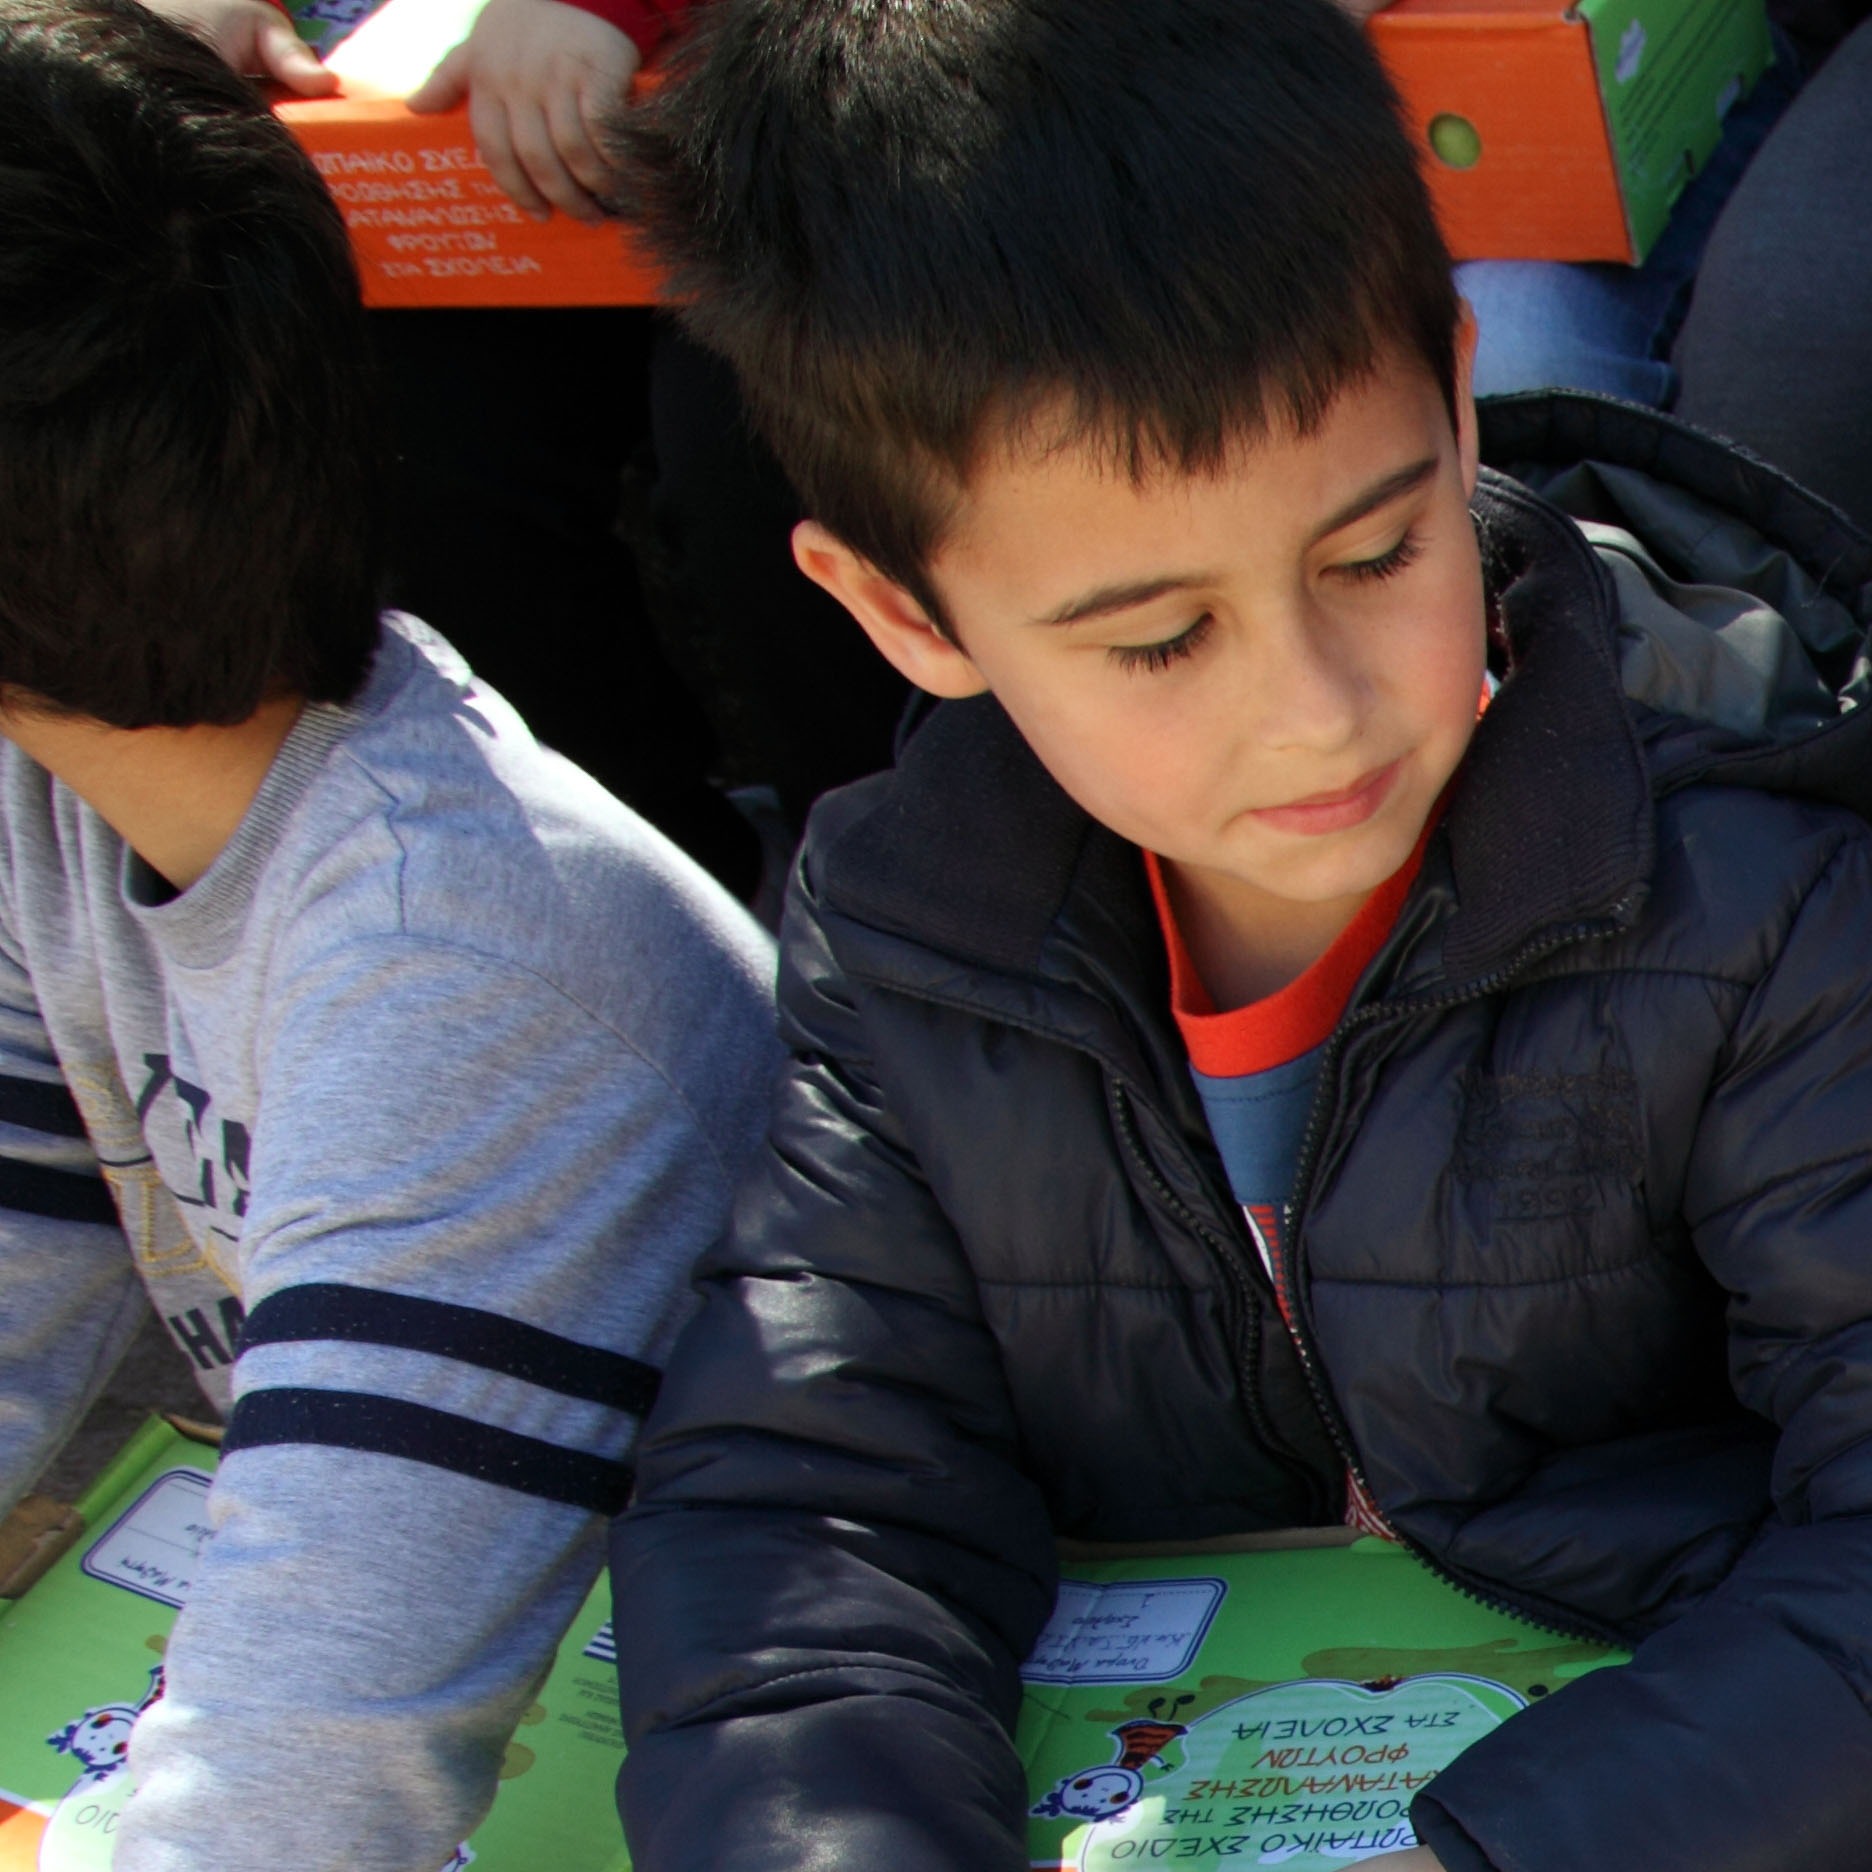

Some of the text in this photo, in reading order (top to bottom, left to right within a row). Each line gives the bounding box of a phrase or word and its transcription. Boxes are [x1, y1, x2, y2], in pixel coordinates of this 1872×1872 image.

[348, 203, 525, 228] ΑΤΑΝΑΛΩΣΗΣ
[424, 255, 543, 278] ΣΧΟΛΕΙΑ
[1232, 1711, 1461, 1741] ΣΤΑ ΣΧΟΛΕΙΑ
[1250, 1742, 1410, 1770] ΦΡΟΥΤΩΝ
[1159, 1806, 1214, 1826] ΤΗΣ
[1110, 1834, 1251, 1861] ΣΧΕΔΙΟ
